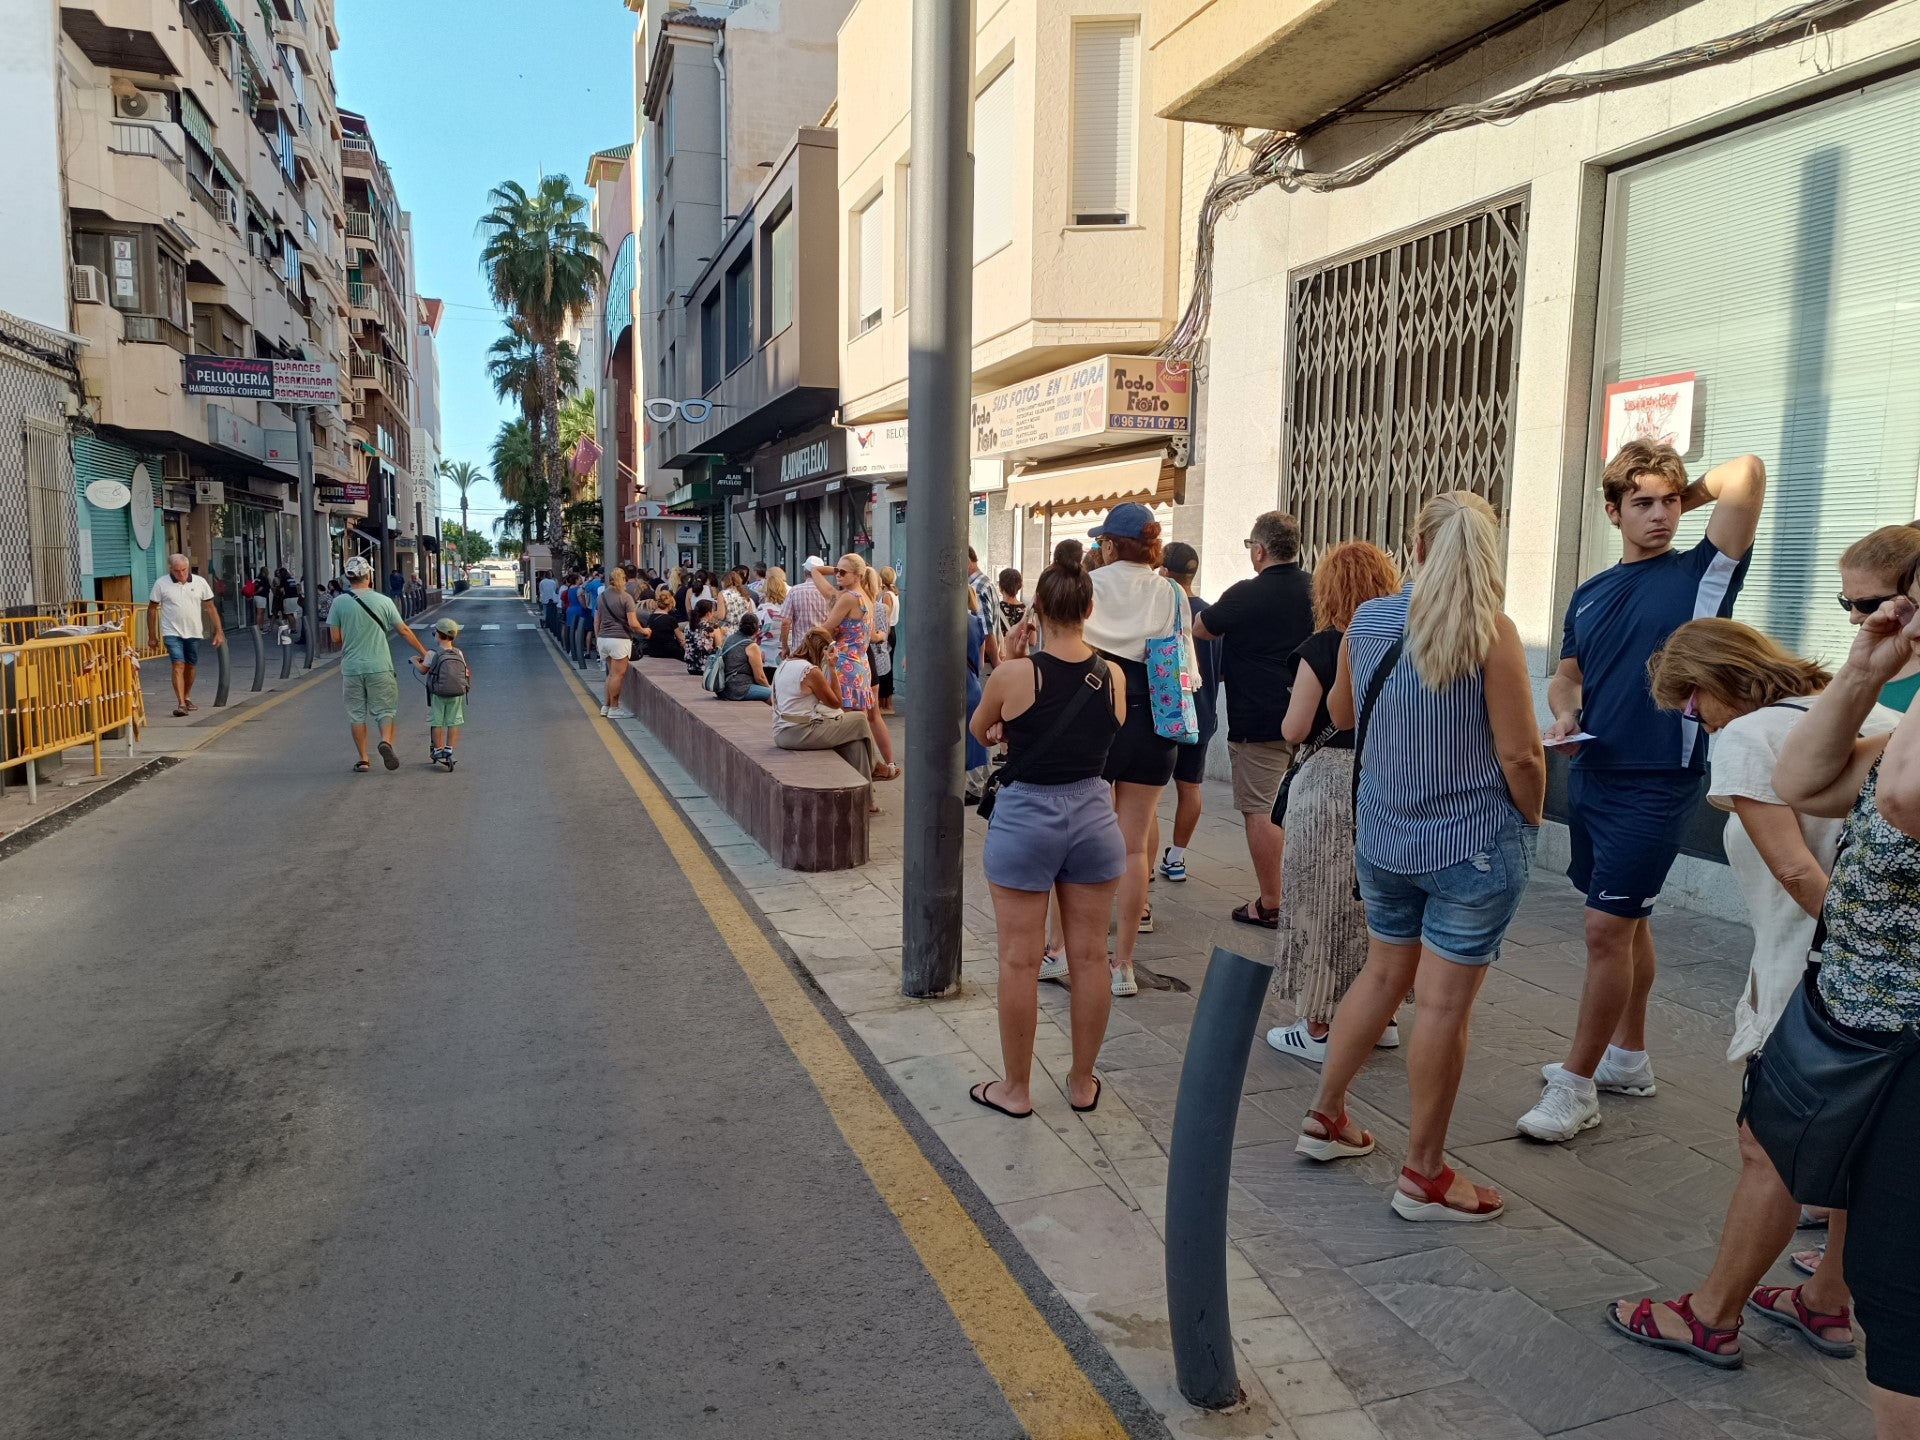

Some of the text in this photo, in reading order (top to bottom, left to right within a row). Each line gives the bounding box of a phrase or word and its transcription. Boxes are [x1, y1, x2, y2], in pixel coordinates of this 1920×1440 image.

[196, 370, 270, 386] PELUQUERÍA
[1114, 368, 1154, 391] Todo
[1162, 374, 1186, 382] Kodak
[189, 384, 272, 397] HAIRDRESSER-COIFFURE
[992, 391, 1008, 412] SUS
[1010, 383, 1041, 408] FOTOS
[1047, 375, 1062, 396] EN
[1071, 363, 1105, 390] HORA
[971, 403, 991, 428] Todo
[1121, 416, 1186, 429] 96 571 07 92
[851, 464, 868, 473] CASIO
